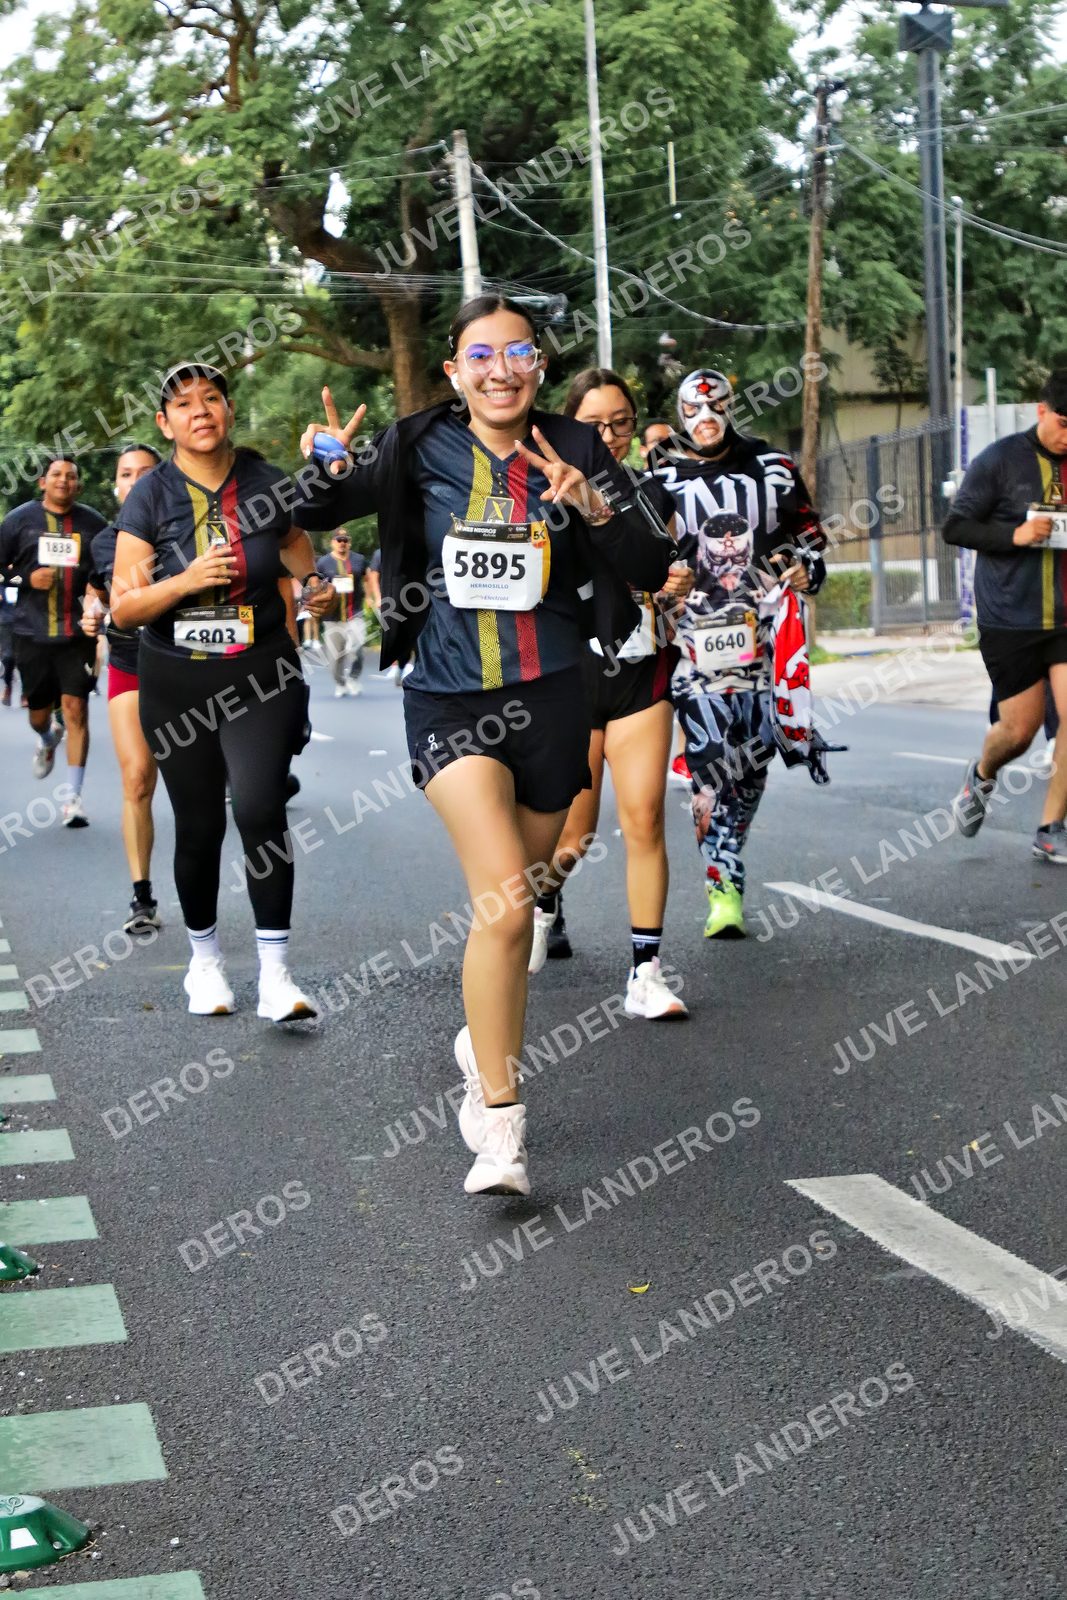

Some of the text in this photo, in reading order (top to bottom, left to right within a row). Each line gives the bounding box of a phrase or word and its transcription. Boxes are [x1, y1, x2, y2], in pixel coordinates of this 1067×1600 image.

[533, 529, 546, 541] 5K
[46, 541, 72, 554] 1838
[453, 550, 526, 580] 5895
[185, 627, 236, 643] 6803
[704, 632, 746, 652] 6640
